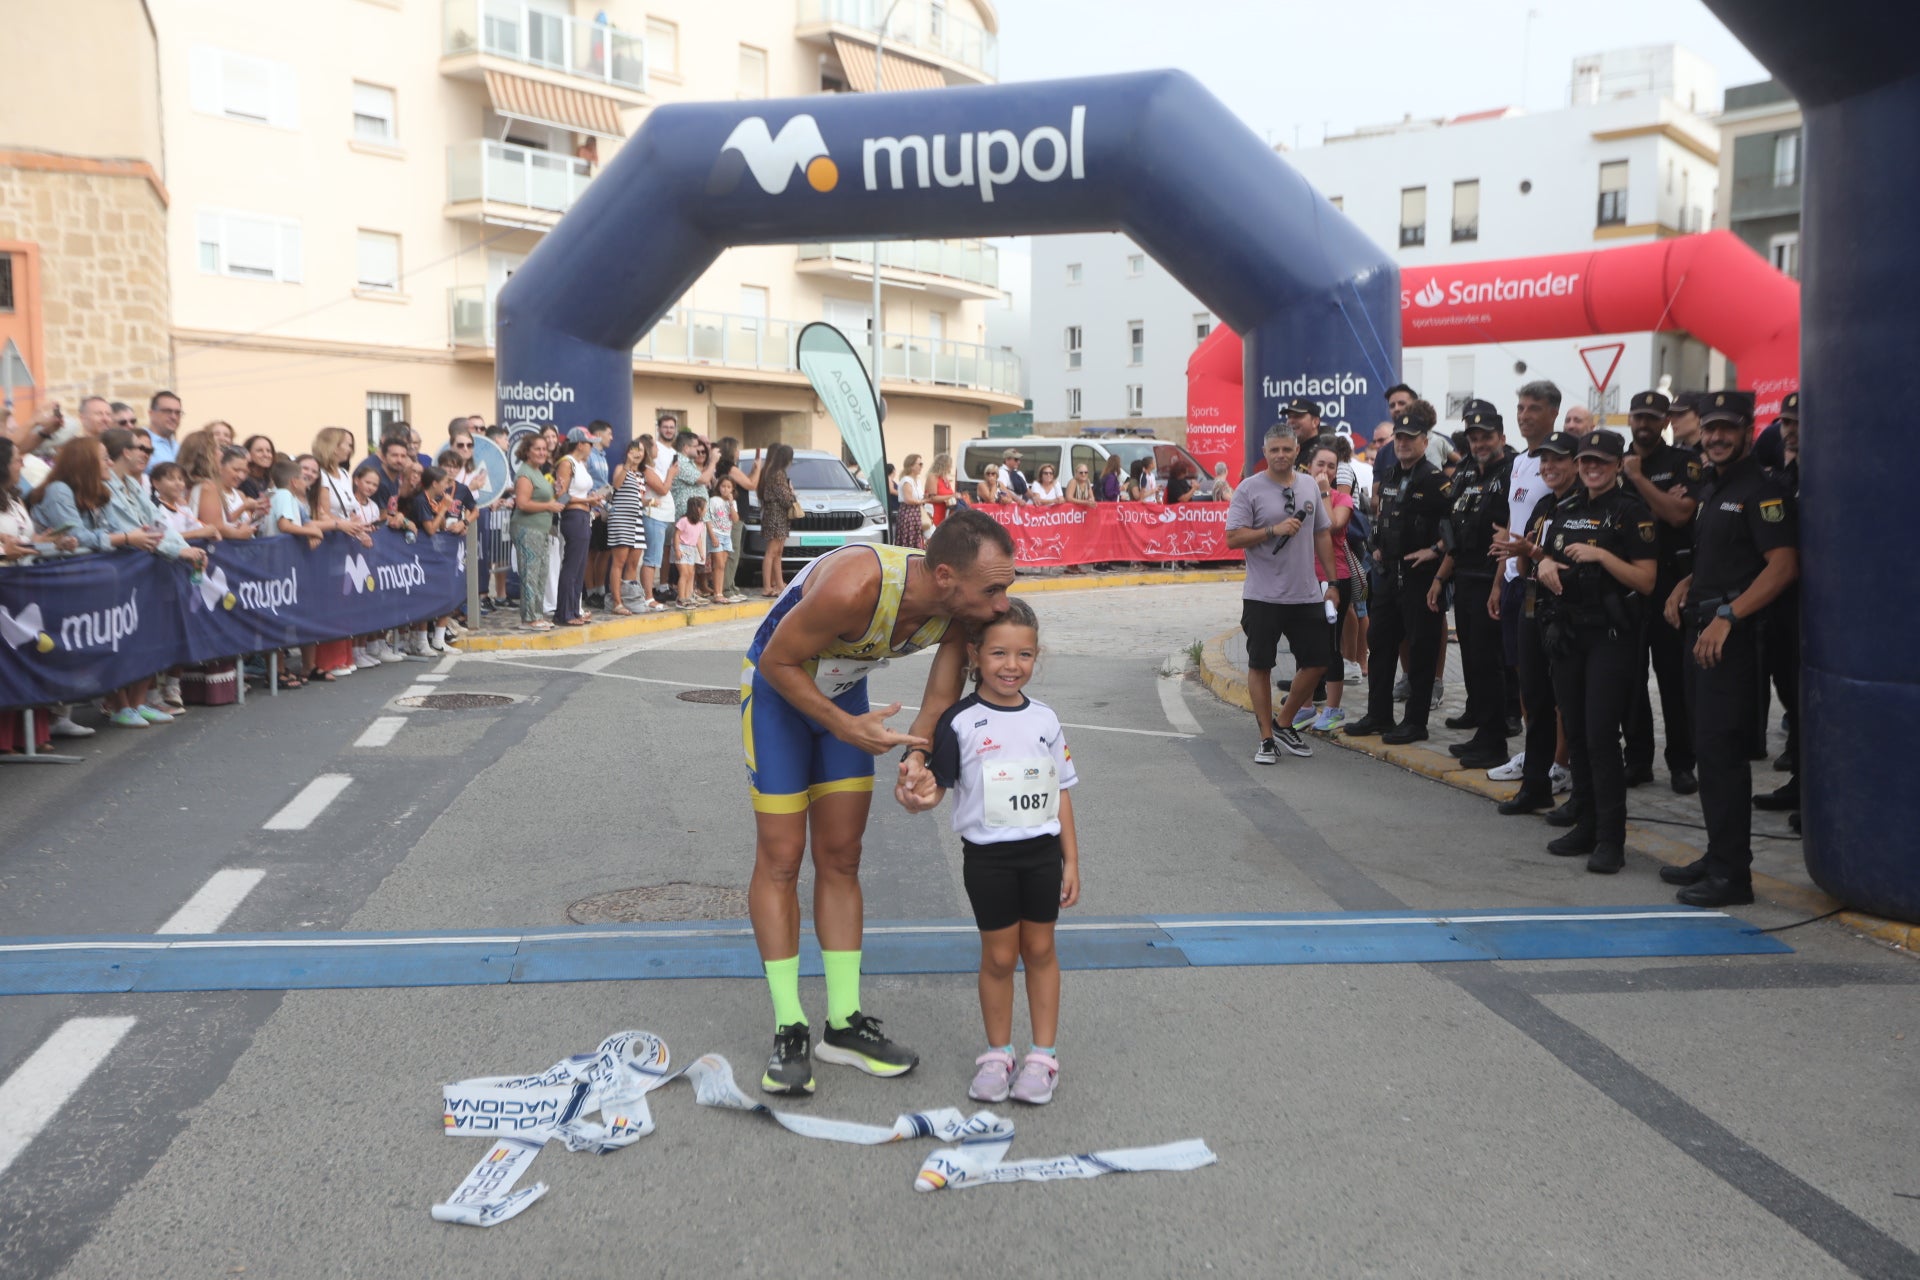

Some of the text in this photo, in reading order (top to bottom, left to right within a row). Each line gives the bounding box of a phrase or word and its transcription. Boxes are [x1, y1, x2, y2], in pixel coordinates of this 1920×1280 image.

[863, 105, 1086, 203] mupol
[1448, 271, 1580, 305] Santander
[1412, 313, 1491, 329] sportssantander.es
[497, 381, 575, 402] fundación
[1262, 373, 1368, 398] fundación
[503, 401, 553, 424] mupol
[1191, 405, 1219, 417] Sports
[1278, 396, 1345, 419] mol
[1189, 423, 1237, 434] Santander
[1023, 508, 1087, 527] Santander
[1116, 505, 1230, 525] Sports Santand
[376, 554, 426, 595] mupol
[238, 566, 298, 616] mupol
[61, 588, 138, 652] mupol
[1009, 793, 1048, 811] 1087
[453, 1111, 556, 1130] POLICIA
